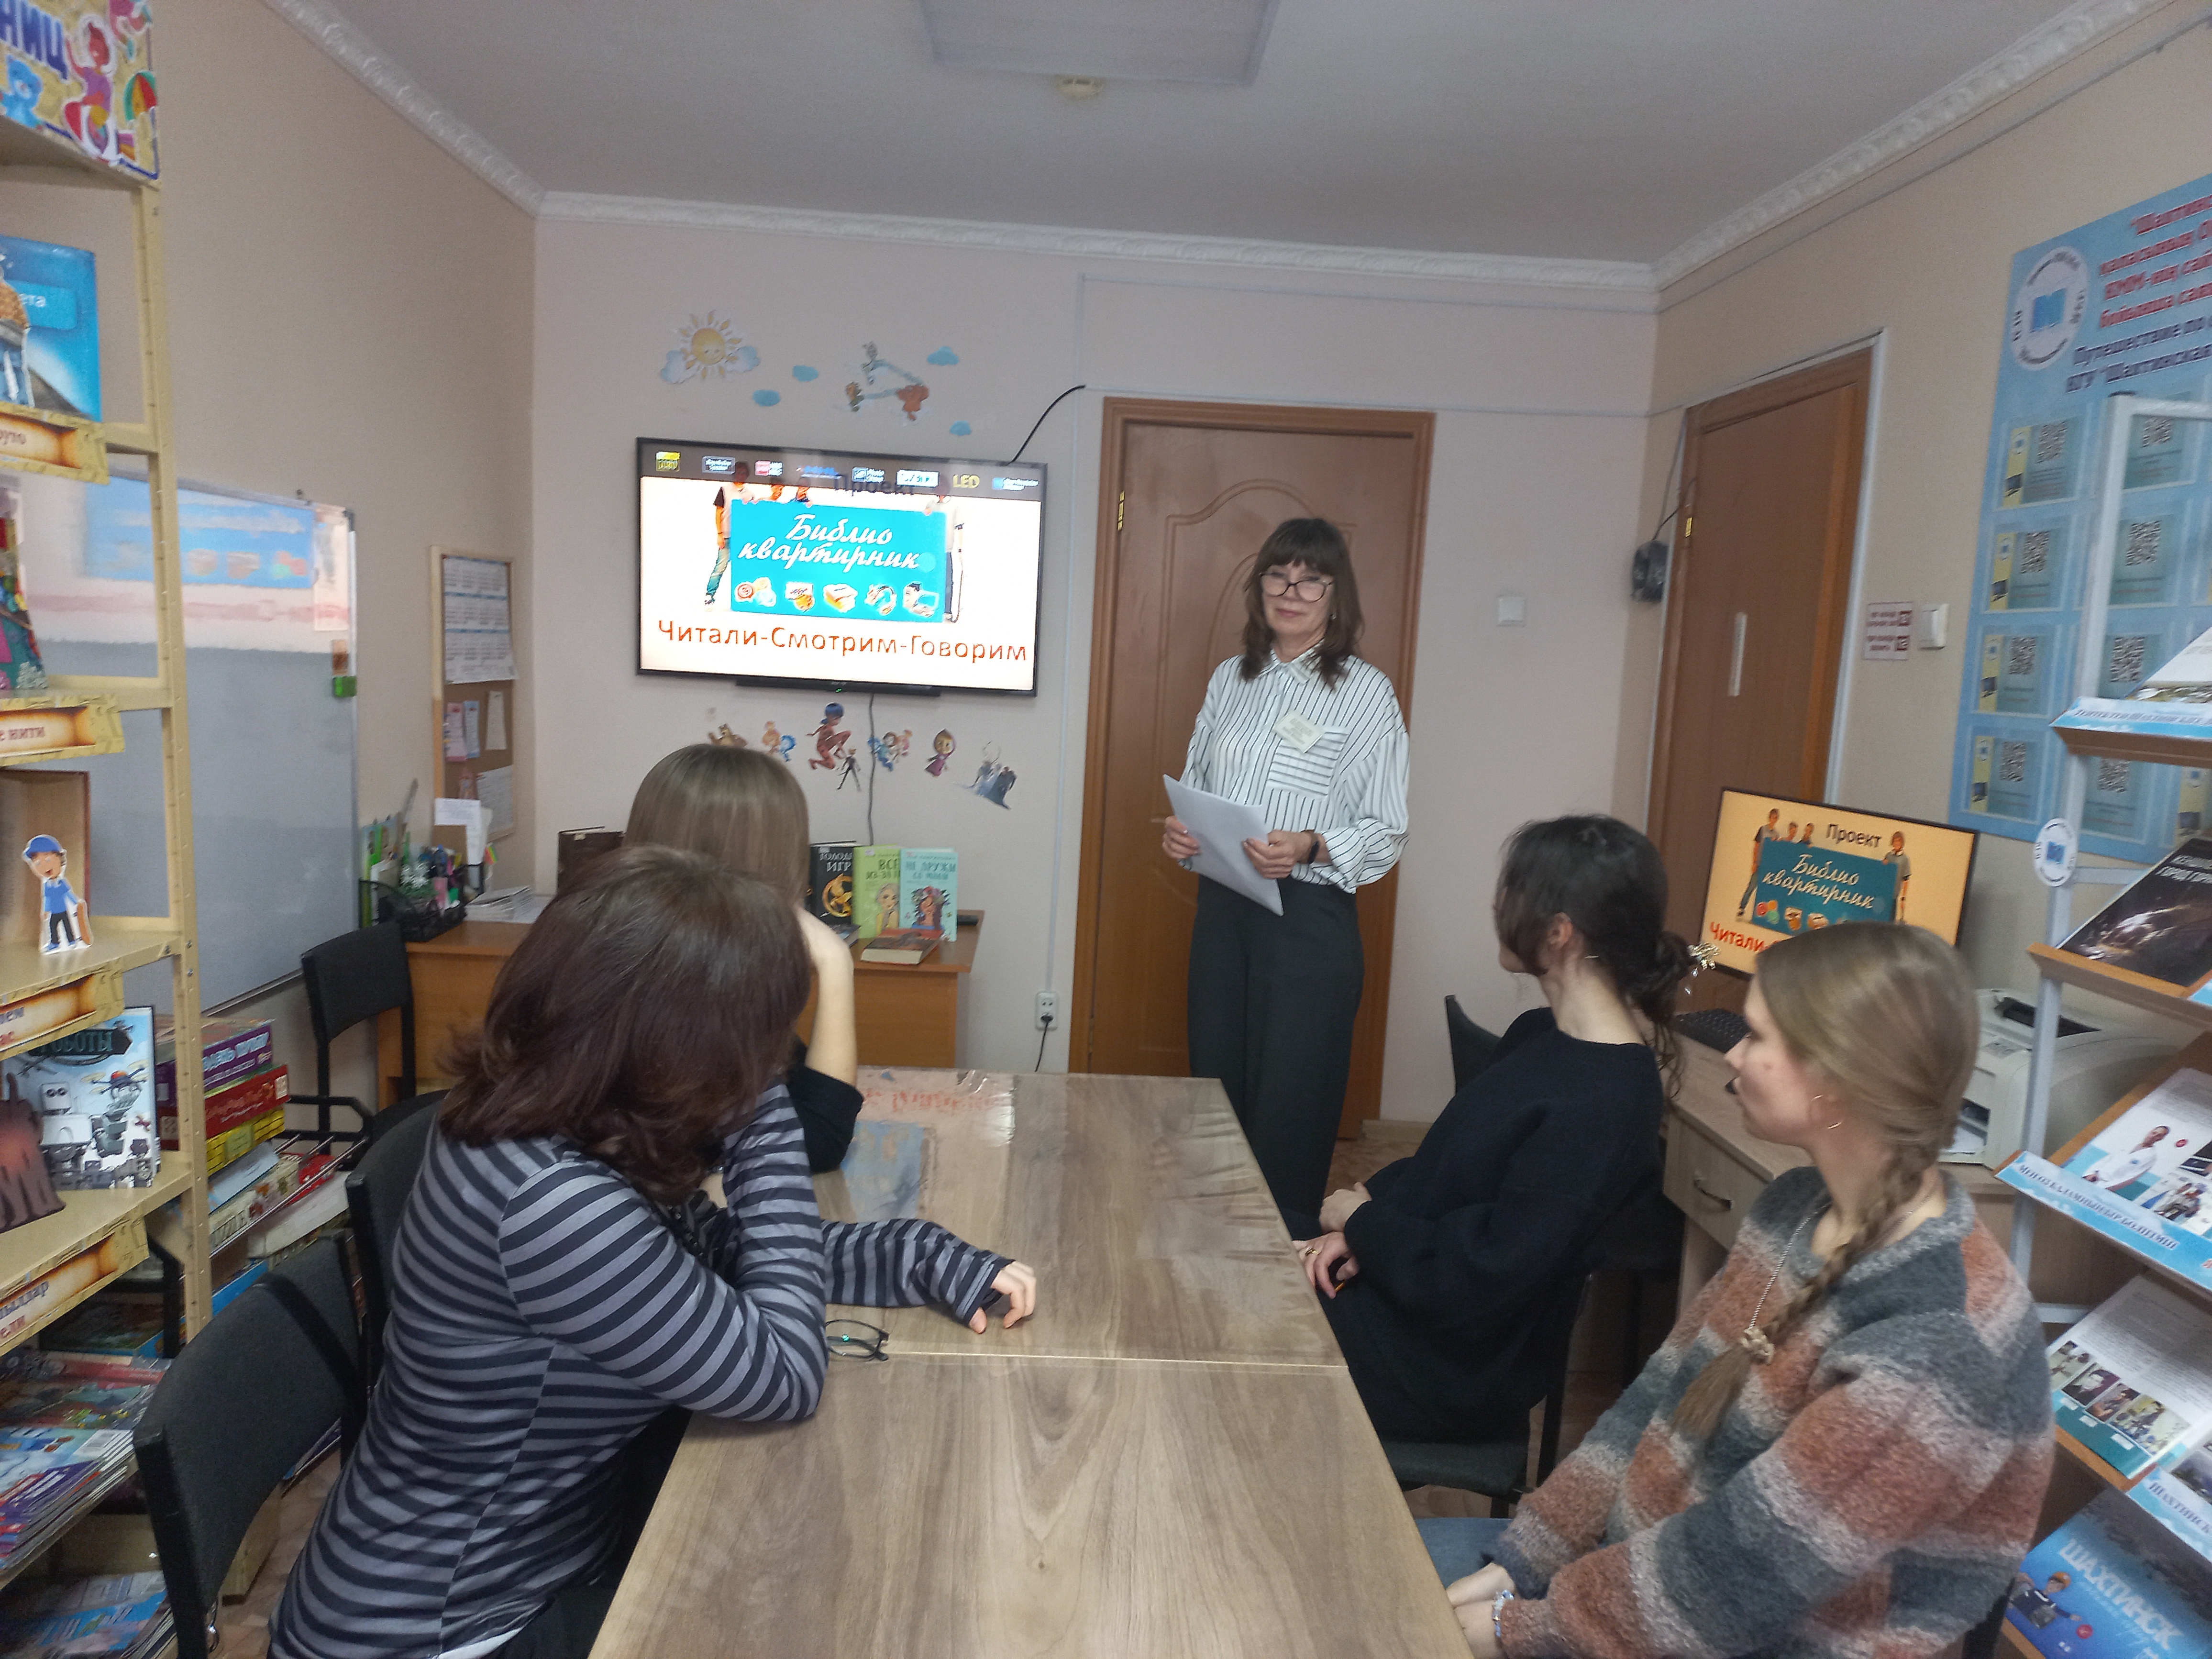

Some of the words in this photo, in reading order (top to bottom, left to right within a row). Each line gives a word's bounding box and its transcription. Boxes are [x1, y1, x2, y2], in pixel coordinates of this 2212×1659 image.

[952, 474, 980, 488] LED
[785, 513, 893, 545] Библио
[738, 536, 919, 573] квартирник
[658, 620, 1027, 664] Читали-Смотрим-Говорим
[1825, 823, 1881, 848] Проект
[1791, 853, 1860, 885] Библио
[1763, 869, 1874, 909] квартирник
[2059, 1538, 2183, 1650] ШАХТИНСК
